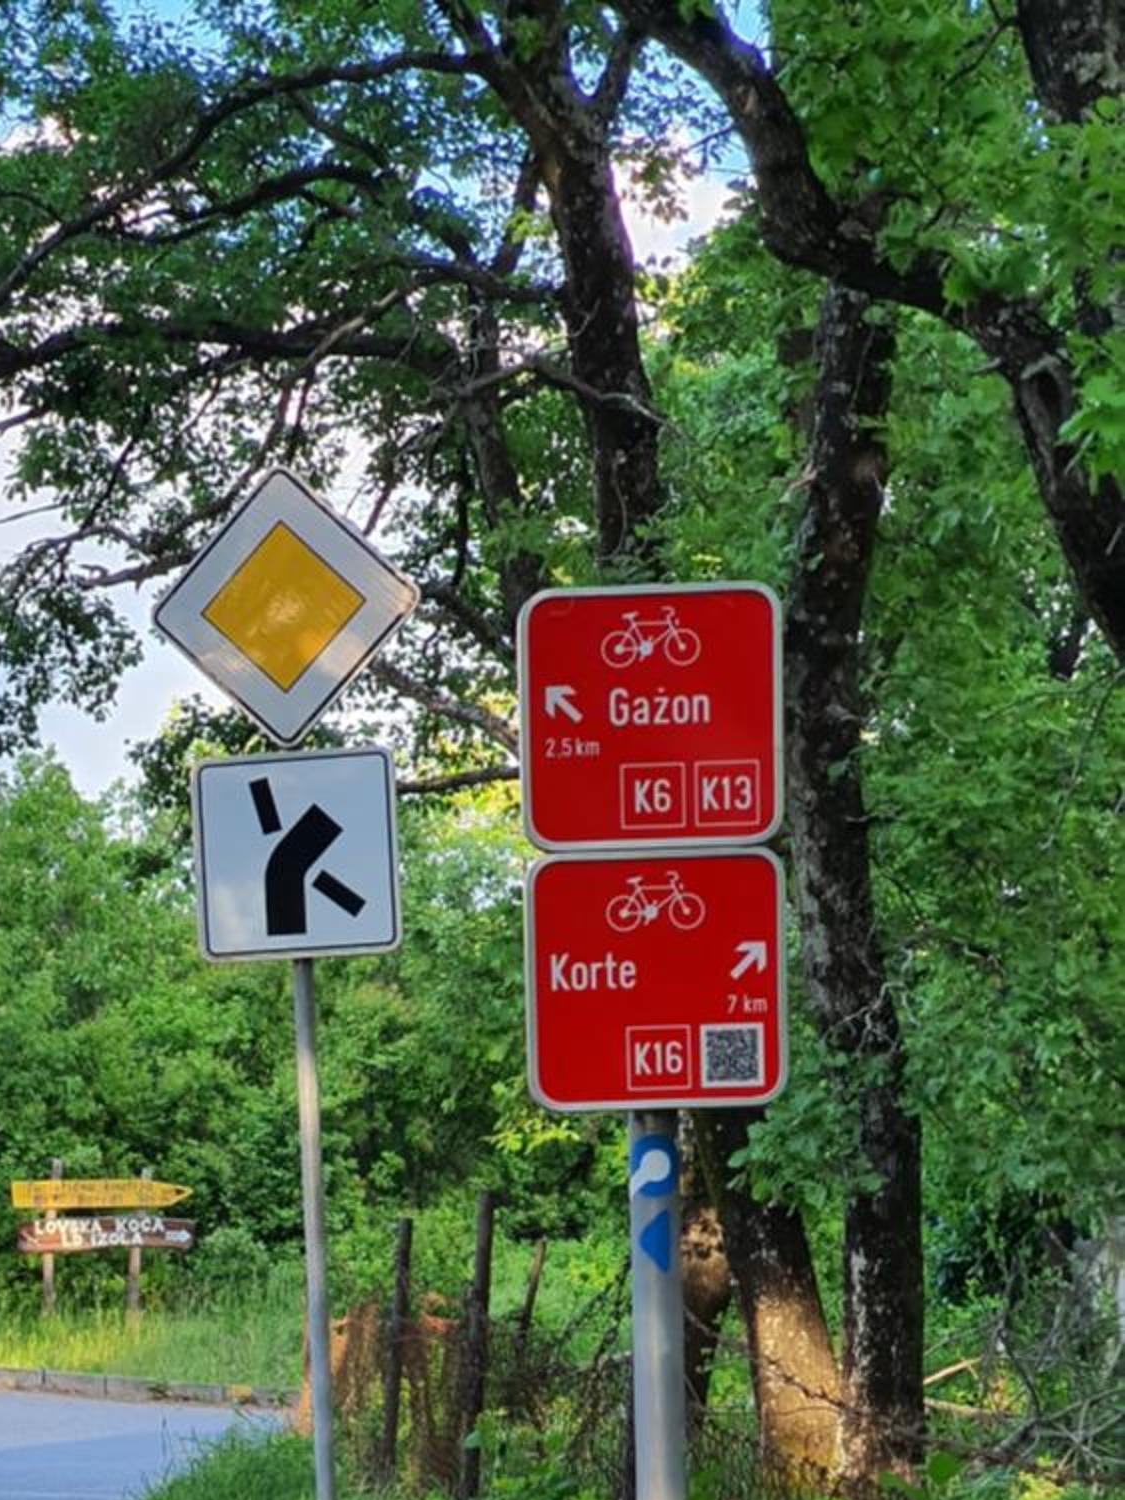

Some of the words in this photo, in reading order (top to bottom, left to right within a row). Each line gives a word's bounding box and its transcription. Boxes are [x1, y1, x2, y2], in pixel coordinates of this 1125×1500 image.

[634, 778, 672, 814] K6
[701, 775, 752, 811] K13
[550, 952, 636, 992] Korte
[727, 995, 737, 1013] 7
[743, 994, 768, 1012] km
[634, 1040, 683, 1076] K16
[91, 1232, 144, 1247] IZOLA
